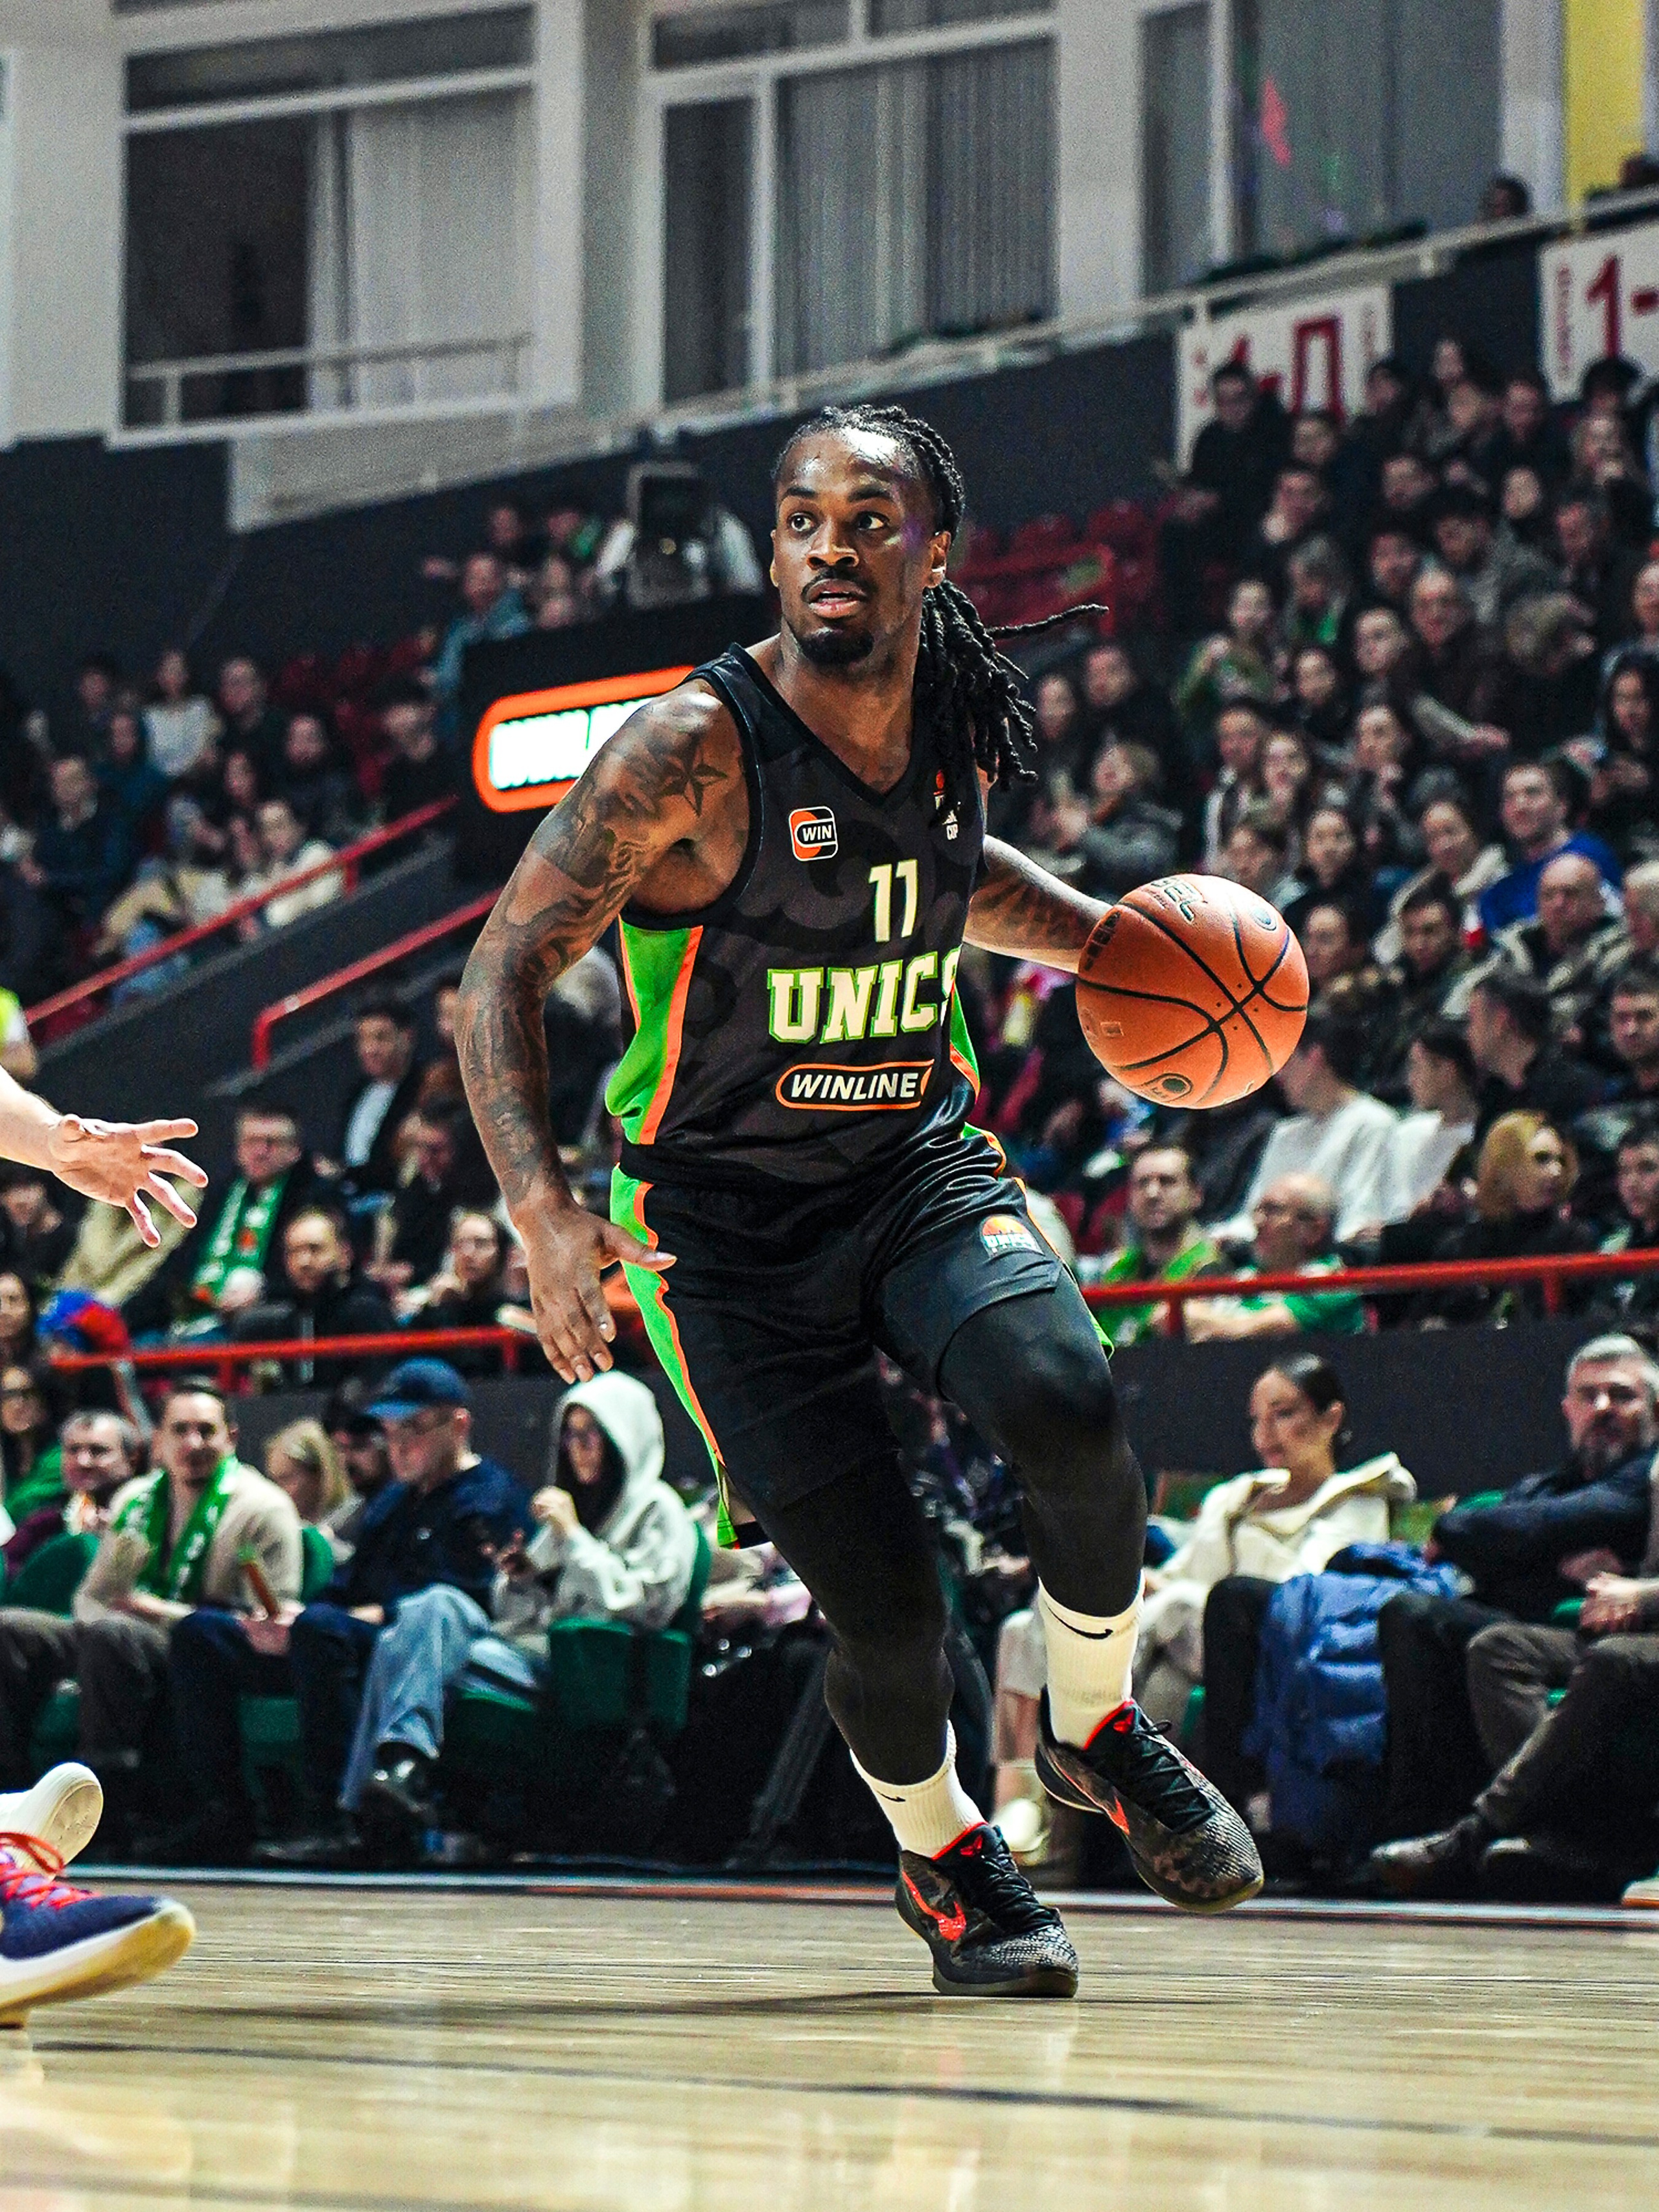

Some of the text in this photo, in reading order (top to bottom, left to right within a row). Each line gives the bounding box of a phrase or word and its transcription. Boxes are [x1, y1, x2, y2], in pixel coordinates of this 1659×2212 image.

[802, 824, 833, 843] WIN
[868, 859, 918, 943] 11
[791, 1073, 919, 1100] WINLINE
